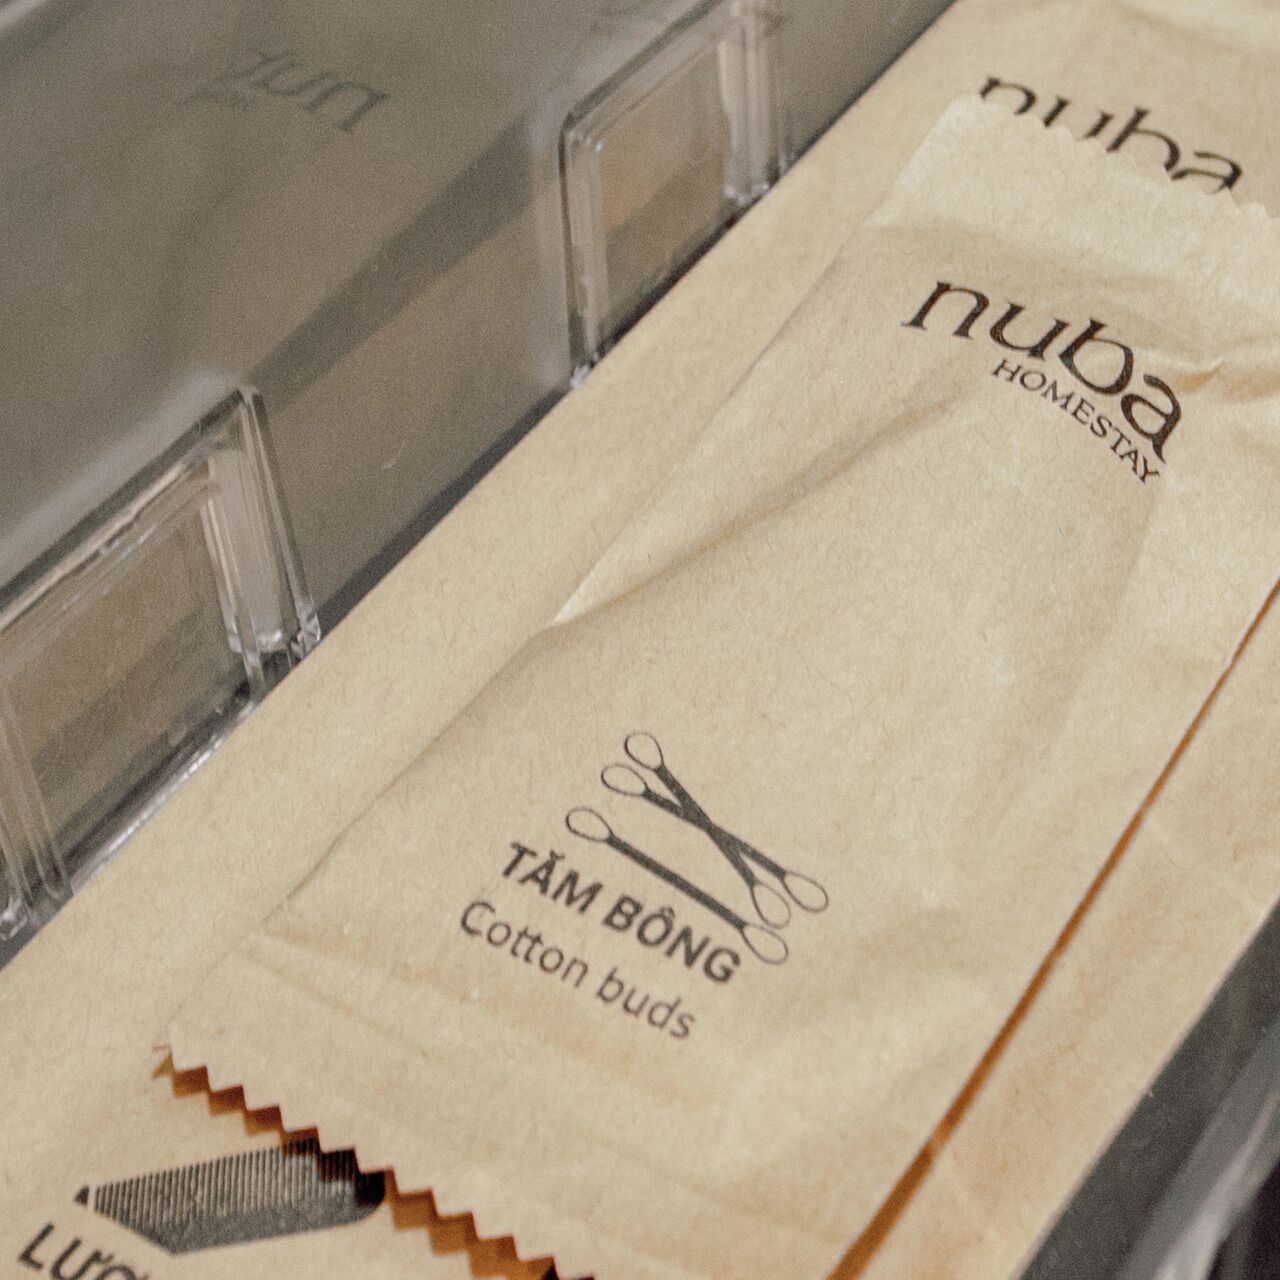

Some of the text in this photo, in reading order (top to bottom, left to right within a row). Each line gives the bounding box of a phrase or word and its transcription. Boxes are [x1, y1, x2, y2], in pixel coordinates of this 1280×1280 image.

[900, 279, 1183, 463] nuba
[991, 358, 1162, 485] HOMESTAY
[458, 899, 698, 1041] Cotton buds
[499, 841, 742, 985] TĂM BÔNG
